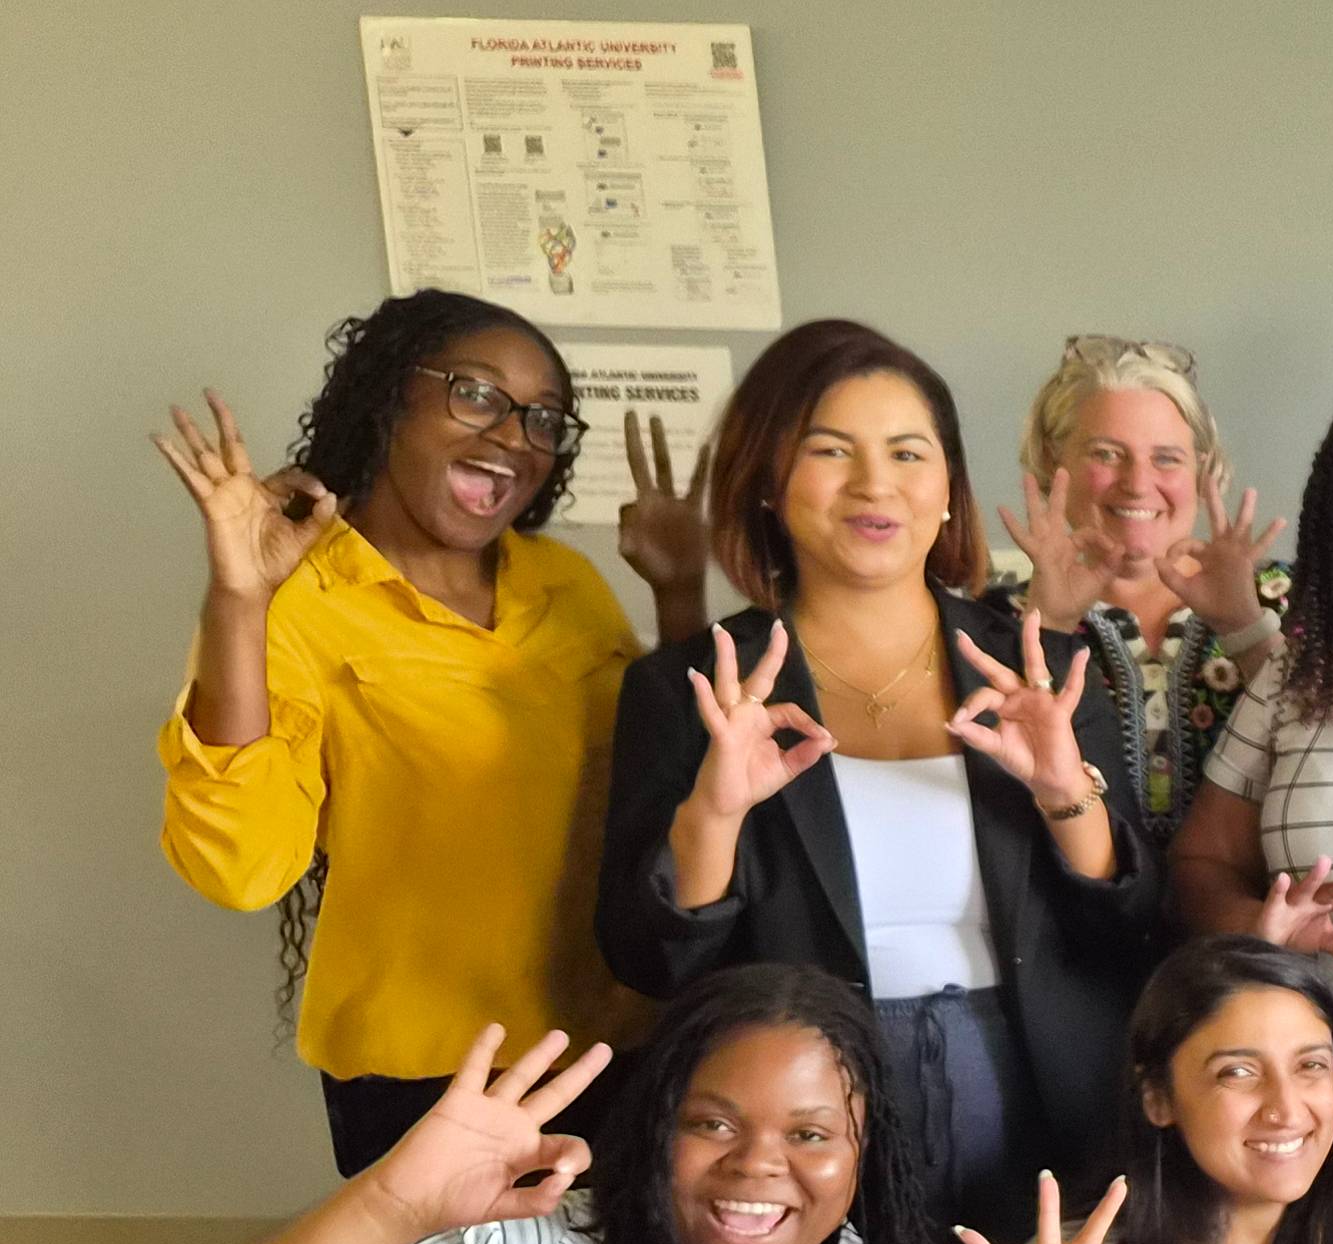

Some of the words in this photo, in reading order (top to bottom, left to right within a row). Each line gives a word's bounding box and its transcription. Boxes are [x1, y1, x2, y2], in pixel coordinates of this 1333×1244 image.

[470, 37, 529, 51] FLORIDA
[532, 38, 595, 53] ATLANTIC
[600, 40, 677, 55] UNIVERSITY
[511, 55, 574, 69] PRINTING
[577, 57, 642, 71] SERVICES
[573, 385, 621, 401] NTING
[626, 385, 700, 402] SERVICES
